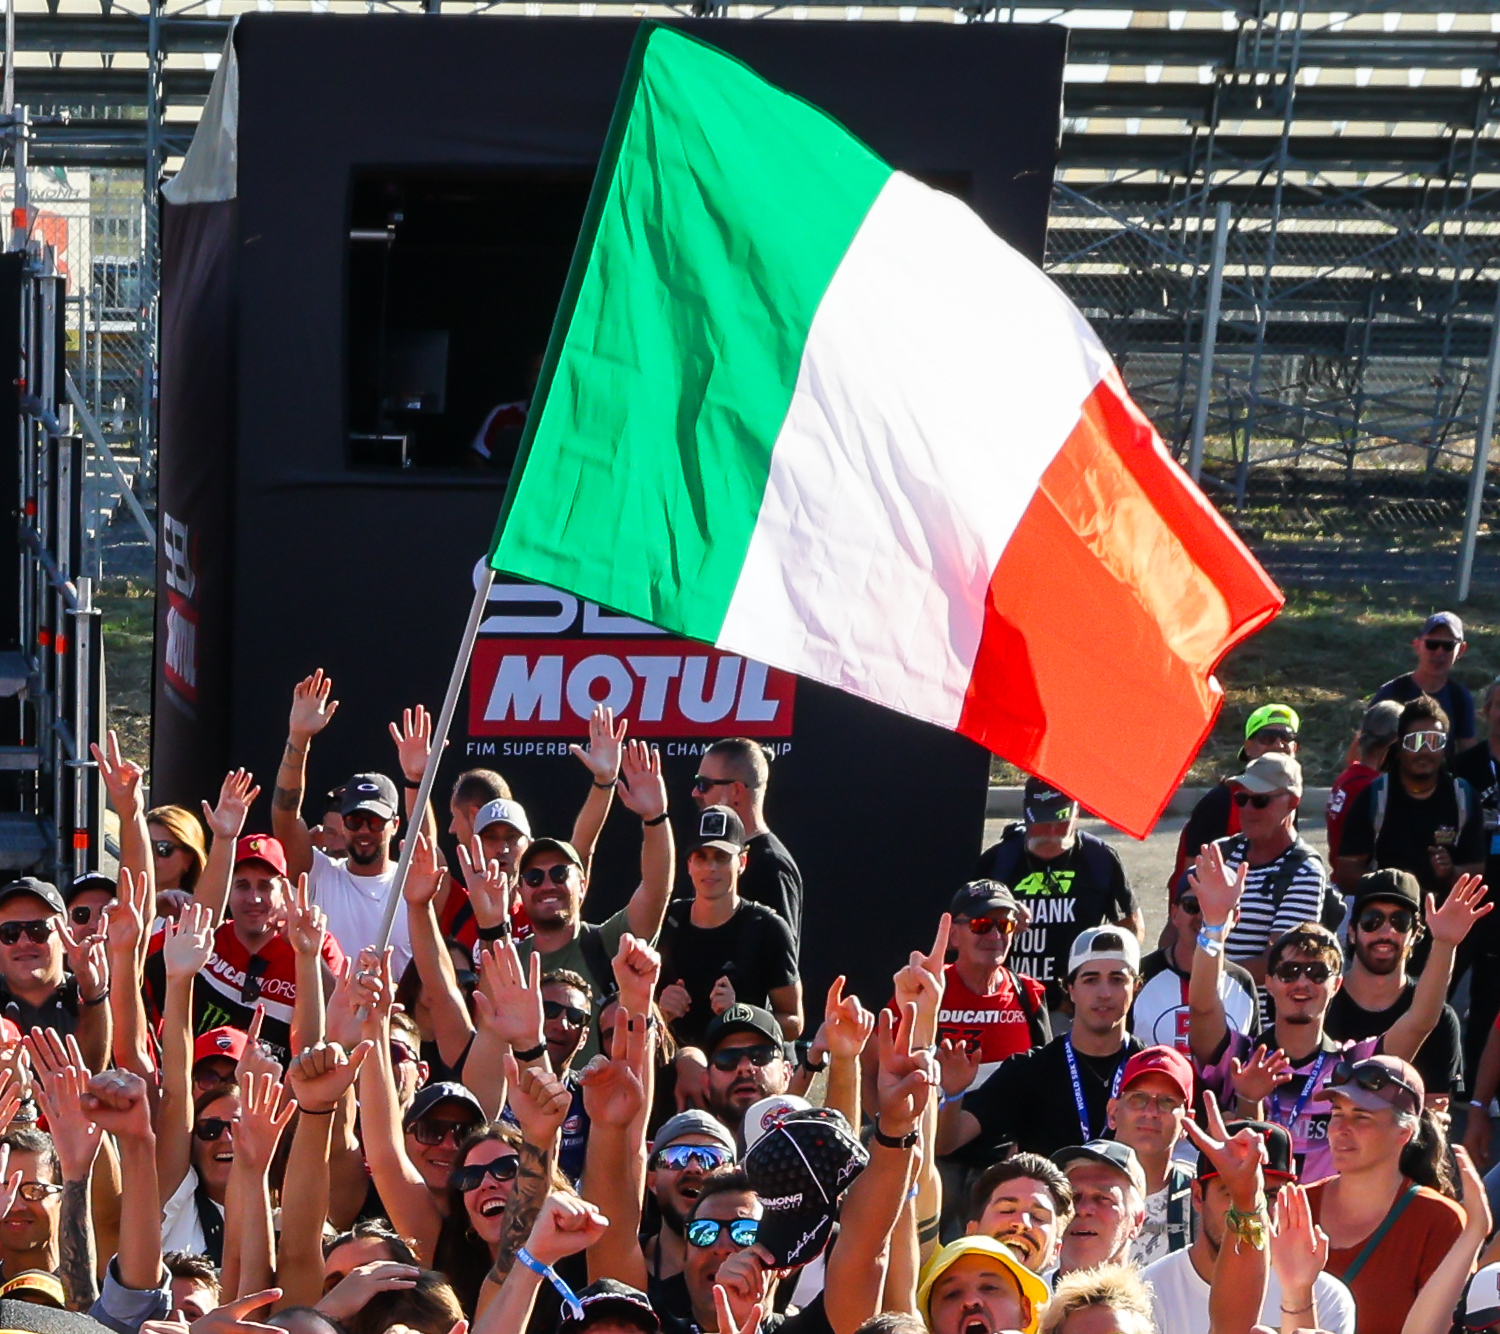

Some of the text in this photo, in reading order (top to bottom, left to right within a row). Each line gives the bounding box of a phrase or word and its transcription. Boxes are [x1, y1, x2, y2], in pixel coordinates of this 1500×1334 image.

[484, 654, 782, 724] MOTUL
[466, 743, 494, 756] FIM
[1008, 897, 1076, 924] HANK
[939, 1010, 1028, 1024] DUCATI CORS
